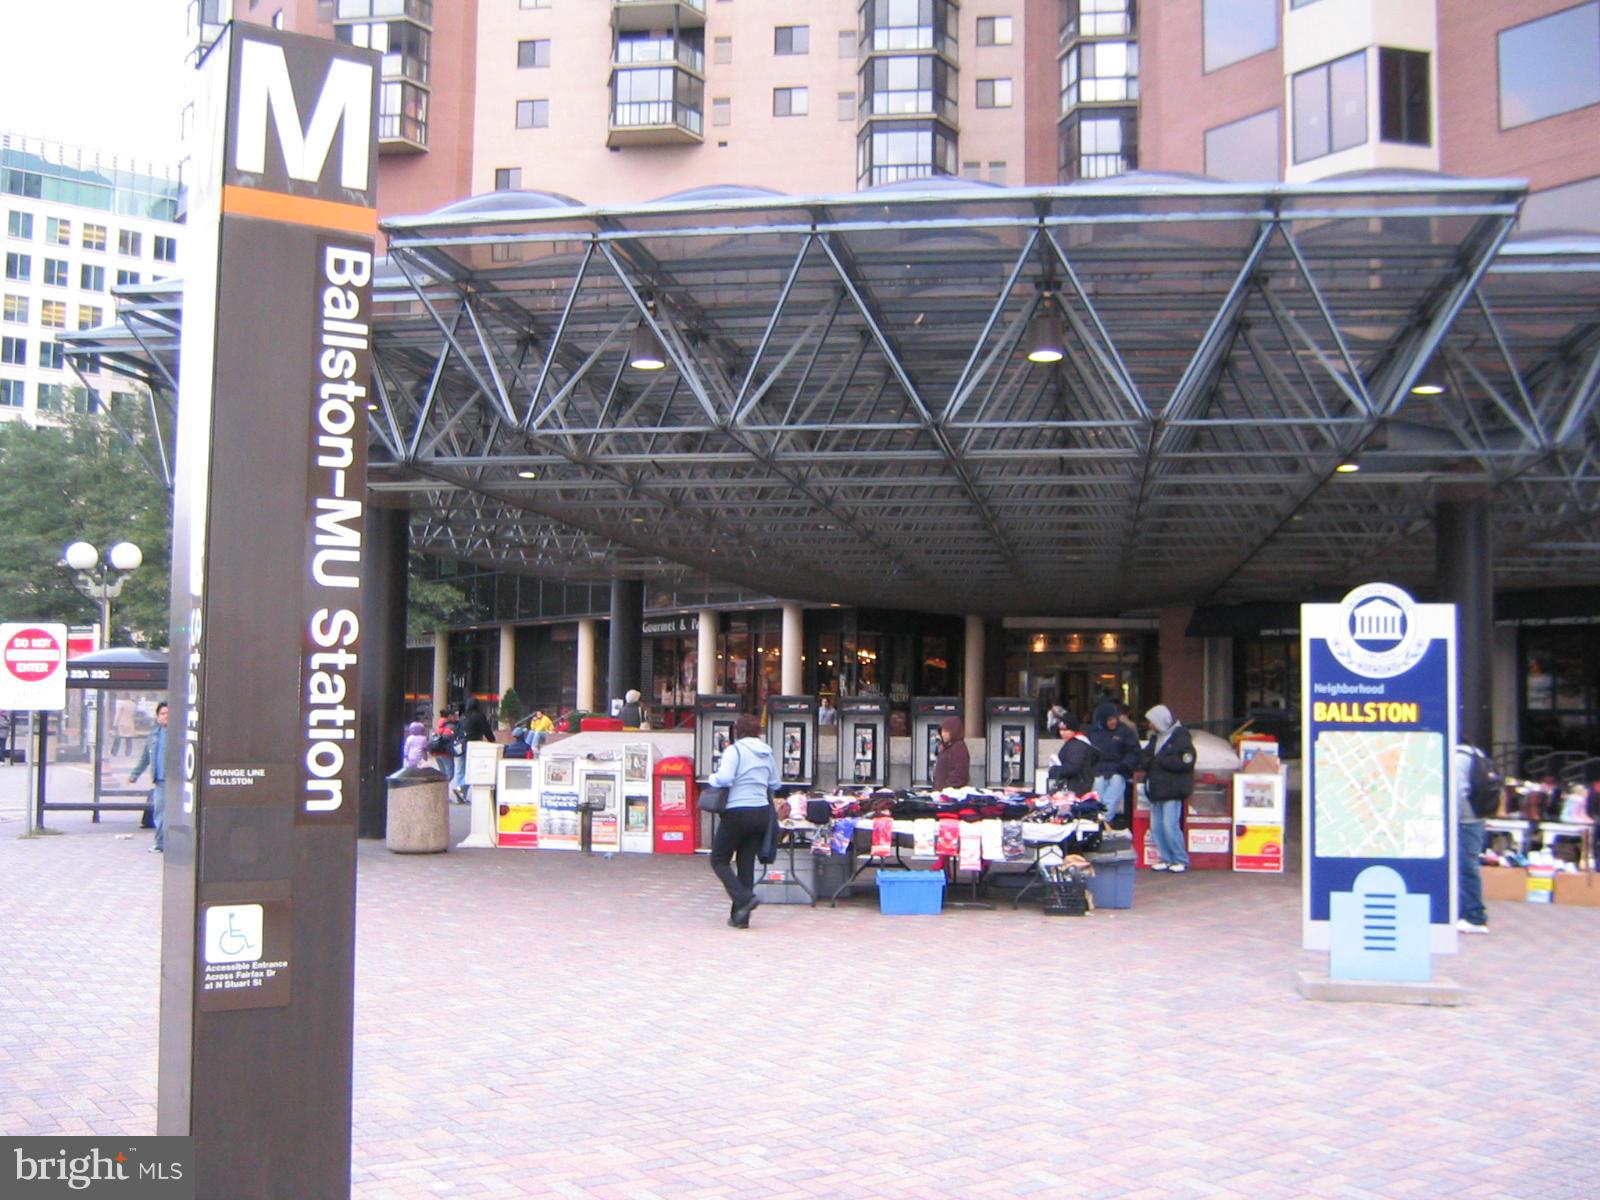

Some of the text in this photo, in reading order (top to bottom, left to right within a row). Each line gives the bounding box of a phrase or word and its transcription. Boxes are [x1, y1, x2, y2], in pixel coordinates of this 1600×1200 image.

[235, 38, 374, 191] M
[642, 620, 676, 633] Gourmet
[679, 618, 687, 631] &
[14, 638, 52, 648] DO NOT
[16, 663, 48, 673] ENTER
[1314, 683, 1385, 696] Neighborhood
[305, 608, 360, 812] Station
[1314, 702, 1419, 722] BALLSTON
[205, 961, 288, 972] Accessible Entrance
[205, 969, 277, 981] Across Fairfax Dr
[205, 982, 213, 990] at
[224, 980, 250, 988] Stuart
